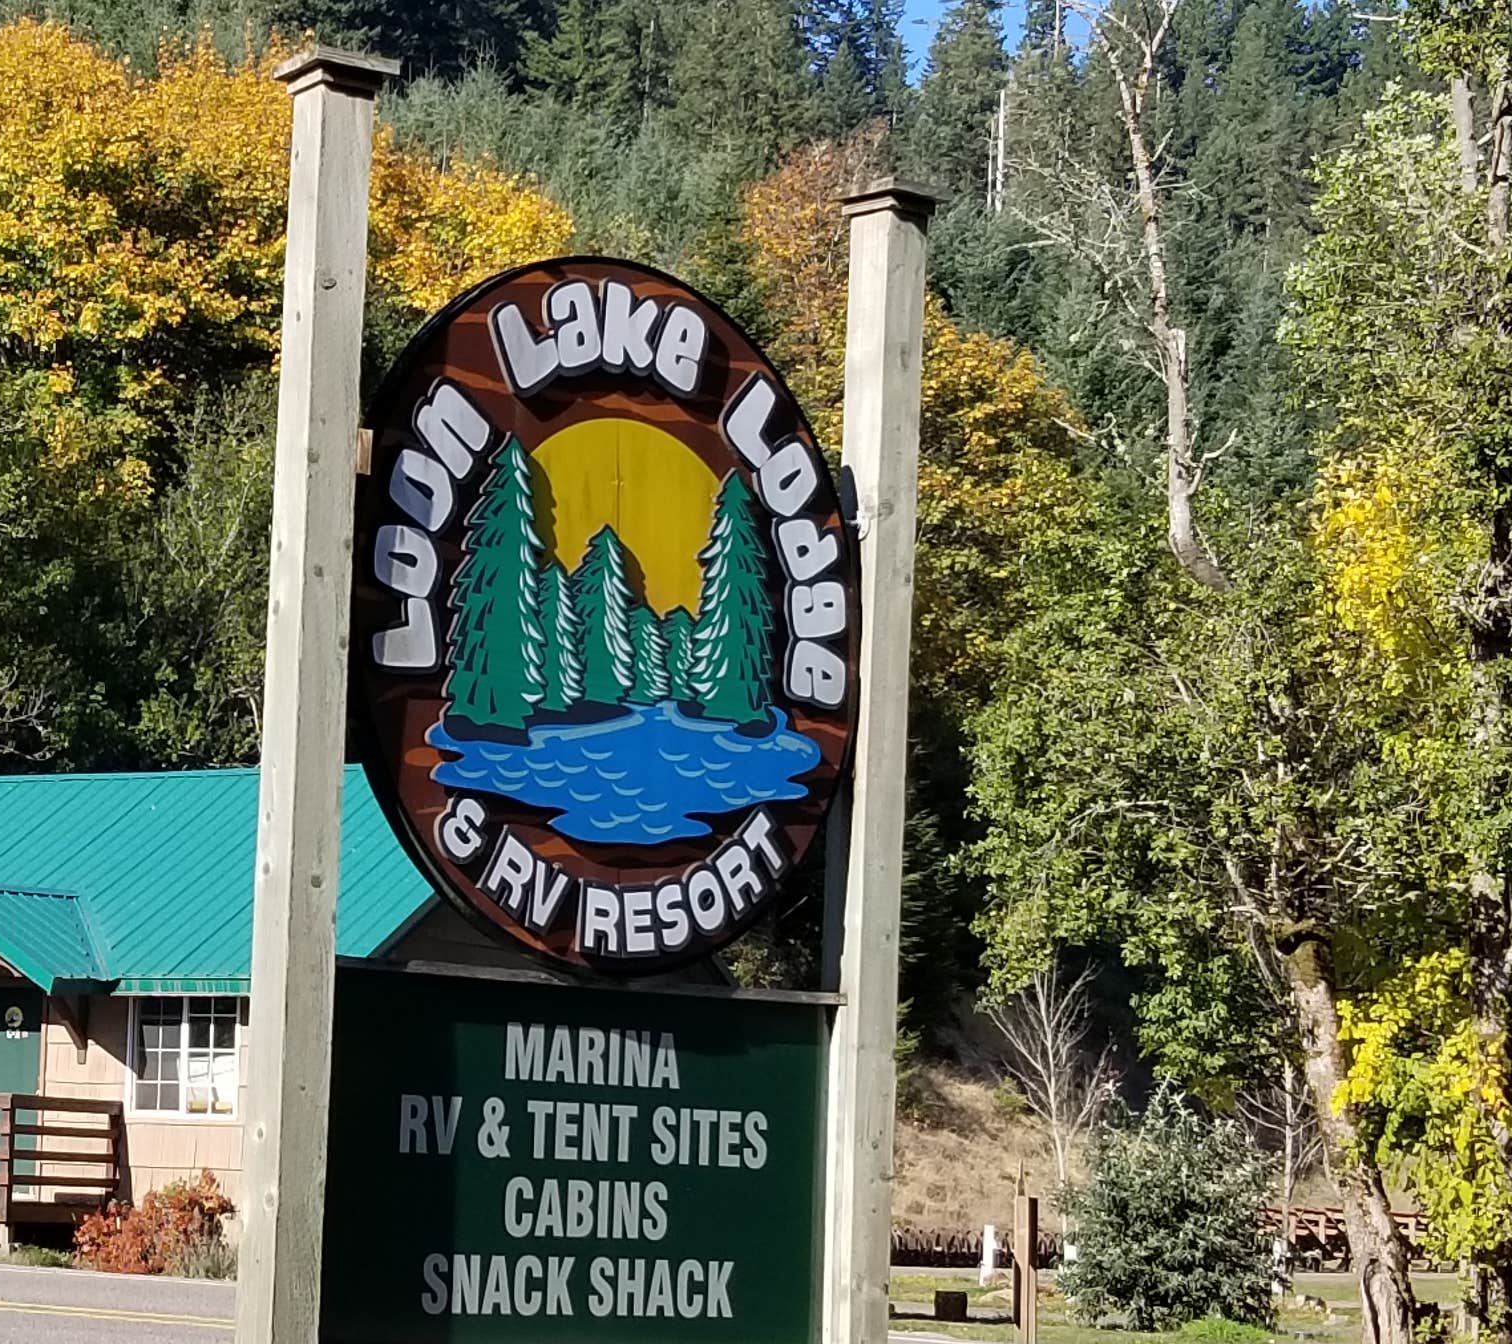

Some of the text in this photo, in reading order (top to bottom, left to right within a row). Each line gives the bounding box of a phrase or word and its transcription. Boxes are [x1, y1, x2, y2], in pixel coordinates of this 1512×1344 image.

[372, 280, 848, 707] Loon Lake Lodge
[442, 797, 783, 955] & RV RESORT
[504, 1022, 680, 1090] MARINA
[398, 1094, 769, 1169] RV & TENT SITES
[504, 1176, 669, 1241] CABINS
[421, 1253, 735, 1319] SNACK SHACK
